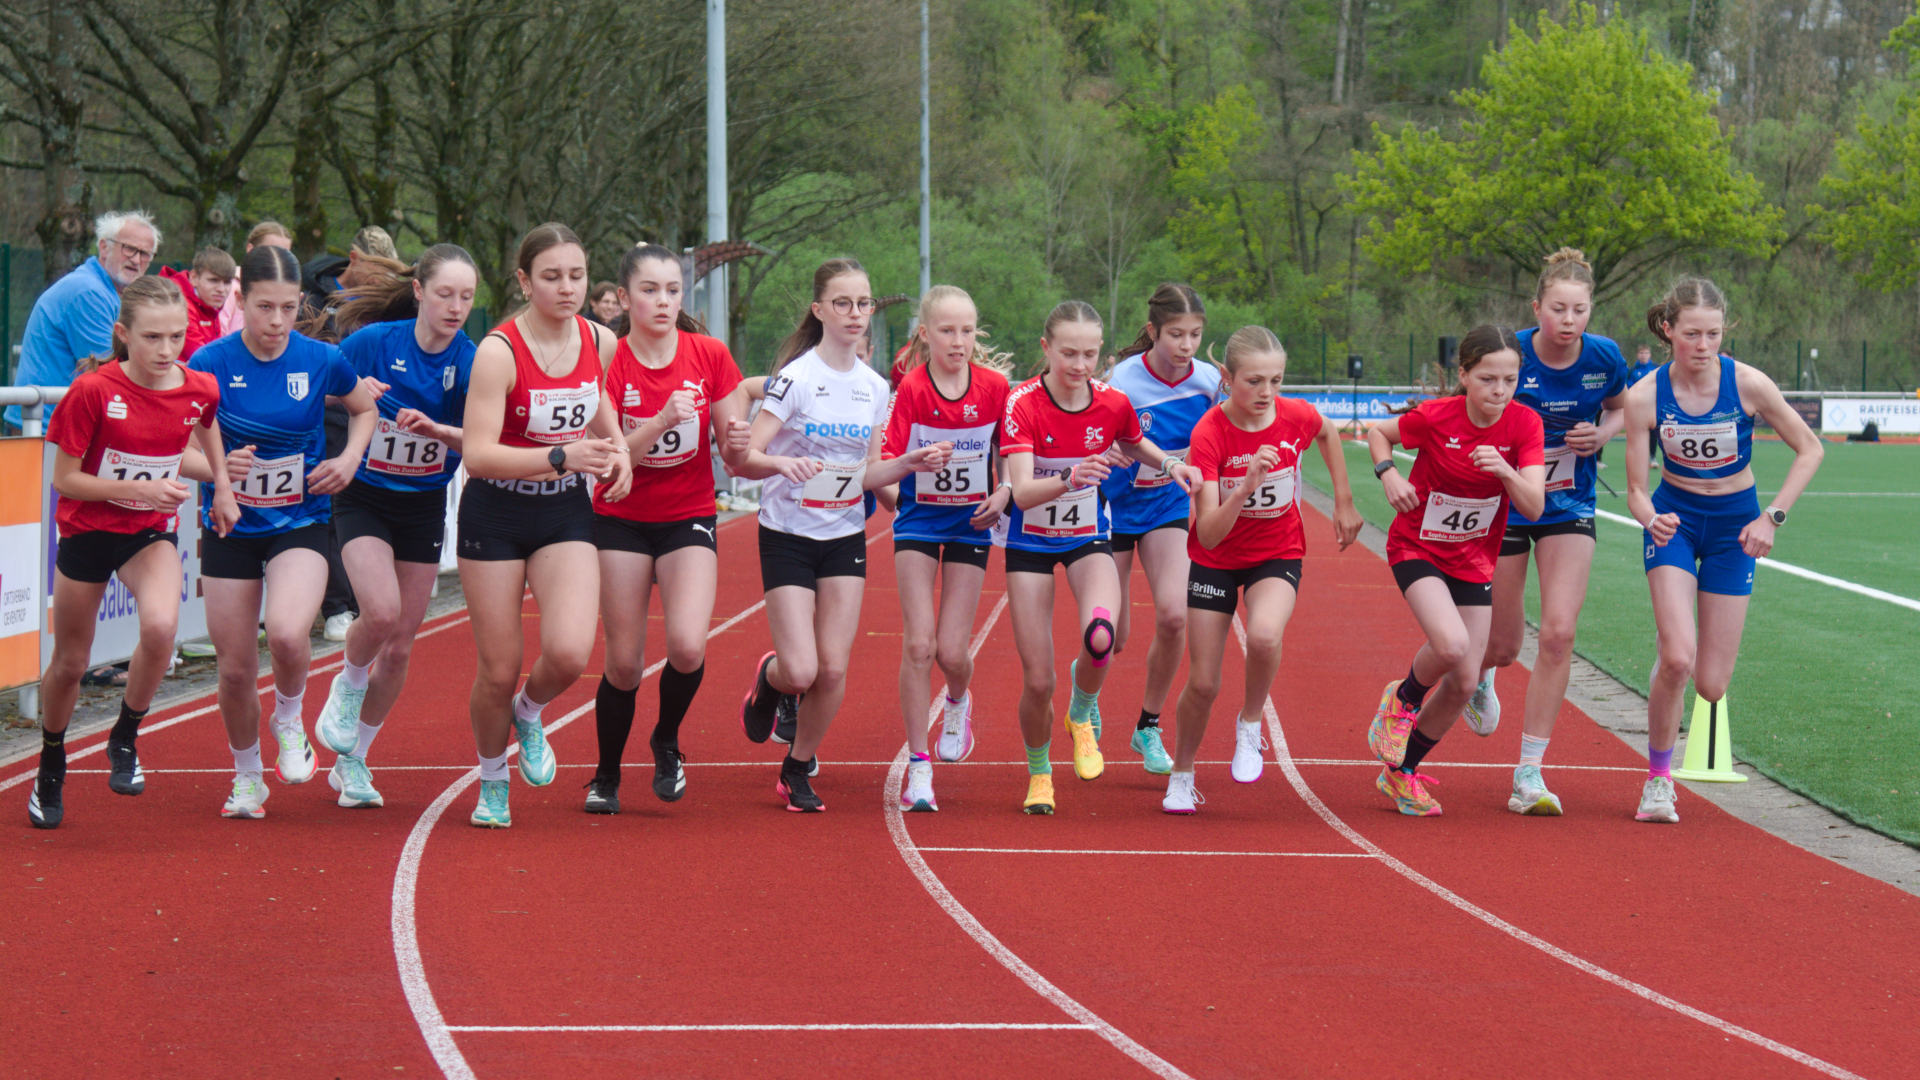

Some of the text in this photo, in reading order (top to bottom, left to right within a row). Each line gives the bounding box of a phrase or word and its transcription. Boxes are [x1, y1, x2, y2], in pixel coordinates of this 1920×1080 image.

[549, 404, 585, 430] 58
[1859, 405, 1920, 414] RAIFFEISE
[805, 423, 872, 438] POLYGO
[384, 436, 439, 464] 118
[1681, 438, 1718, 458] 86
[483, 474, 578, 496] MOUR
[835, 477, 852, 498] 7
[934, 468, 970, 492] 85
[1045, 505, 1080, 526] 14
[1442, 511, 1480, 530] 46
[1193, 582, 1225, 597] Brillux
